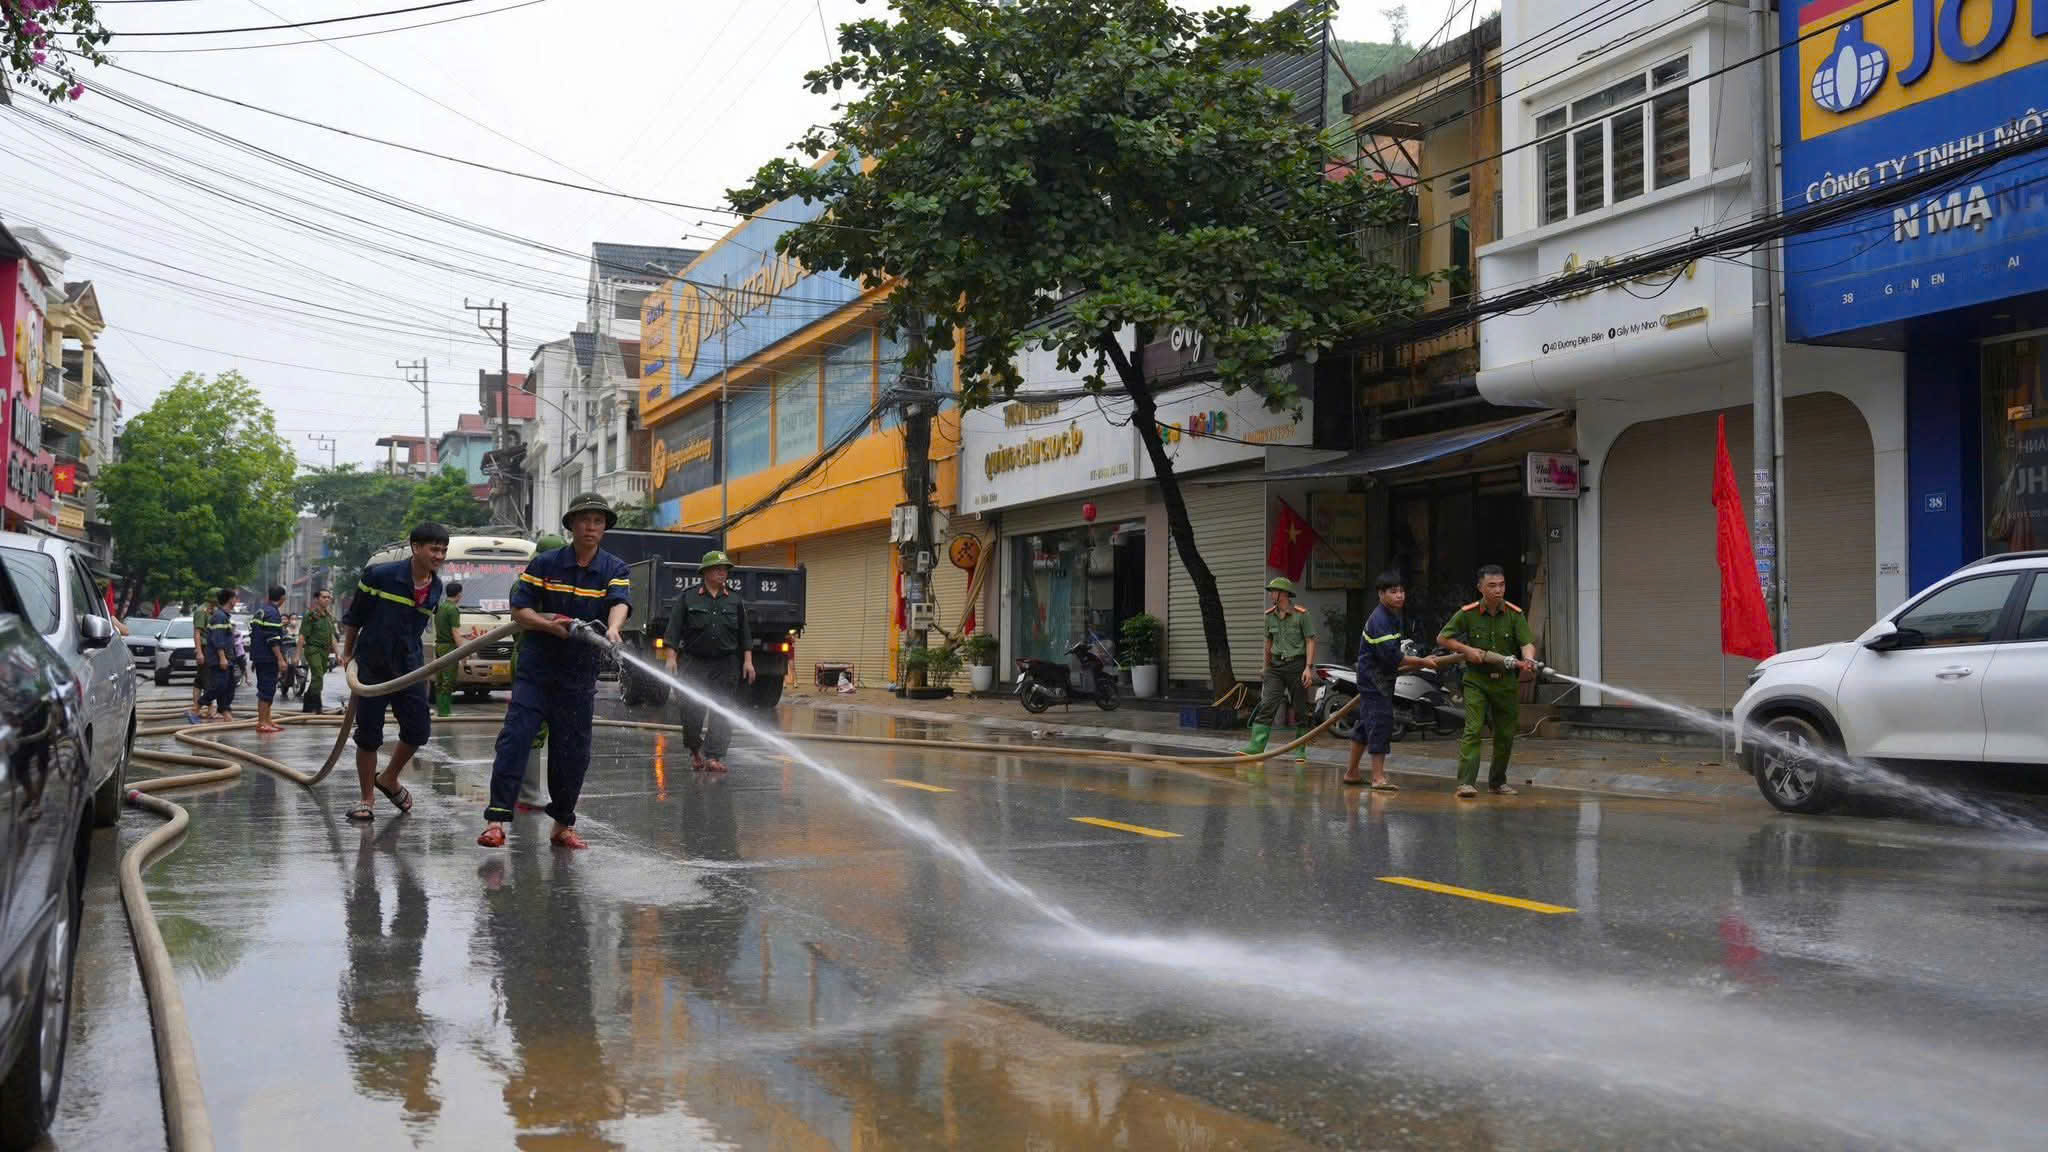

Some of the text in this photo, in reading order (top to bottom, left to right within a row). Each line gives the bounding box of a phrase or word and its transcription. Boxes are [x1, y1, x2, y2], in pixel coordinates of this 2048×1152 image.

[1806, 167, 1870, 204] CÔNG
[1875, 154, 1908, 185] TY
[1914, 132, 1984, 173] TNHH
[1842, 292, 1854, 305] 38
[1929, 496, 1943, 509] 38
[761, 580, 778, 592] 82
